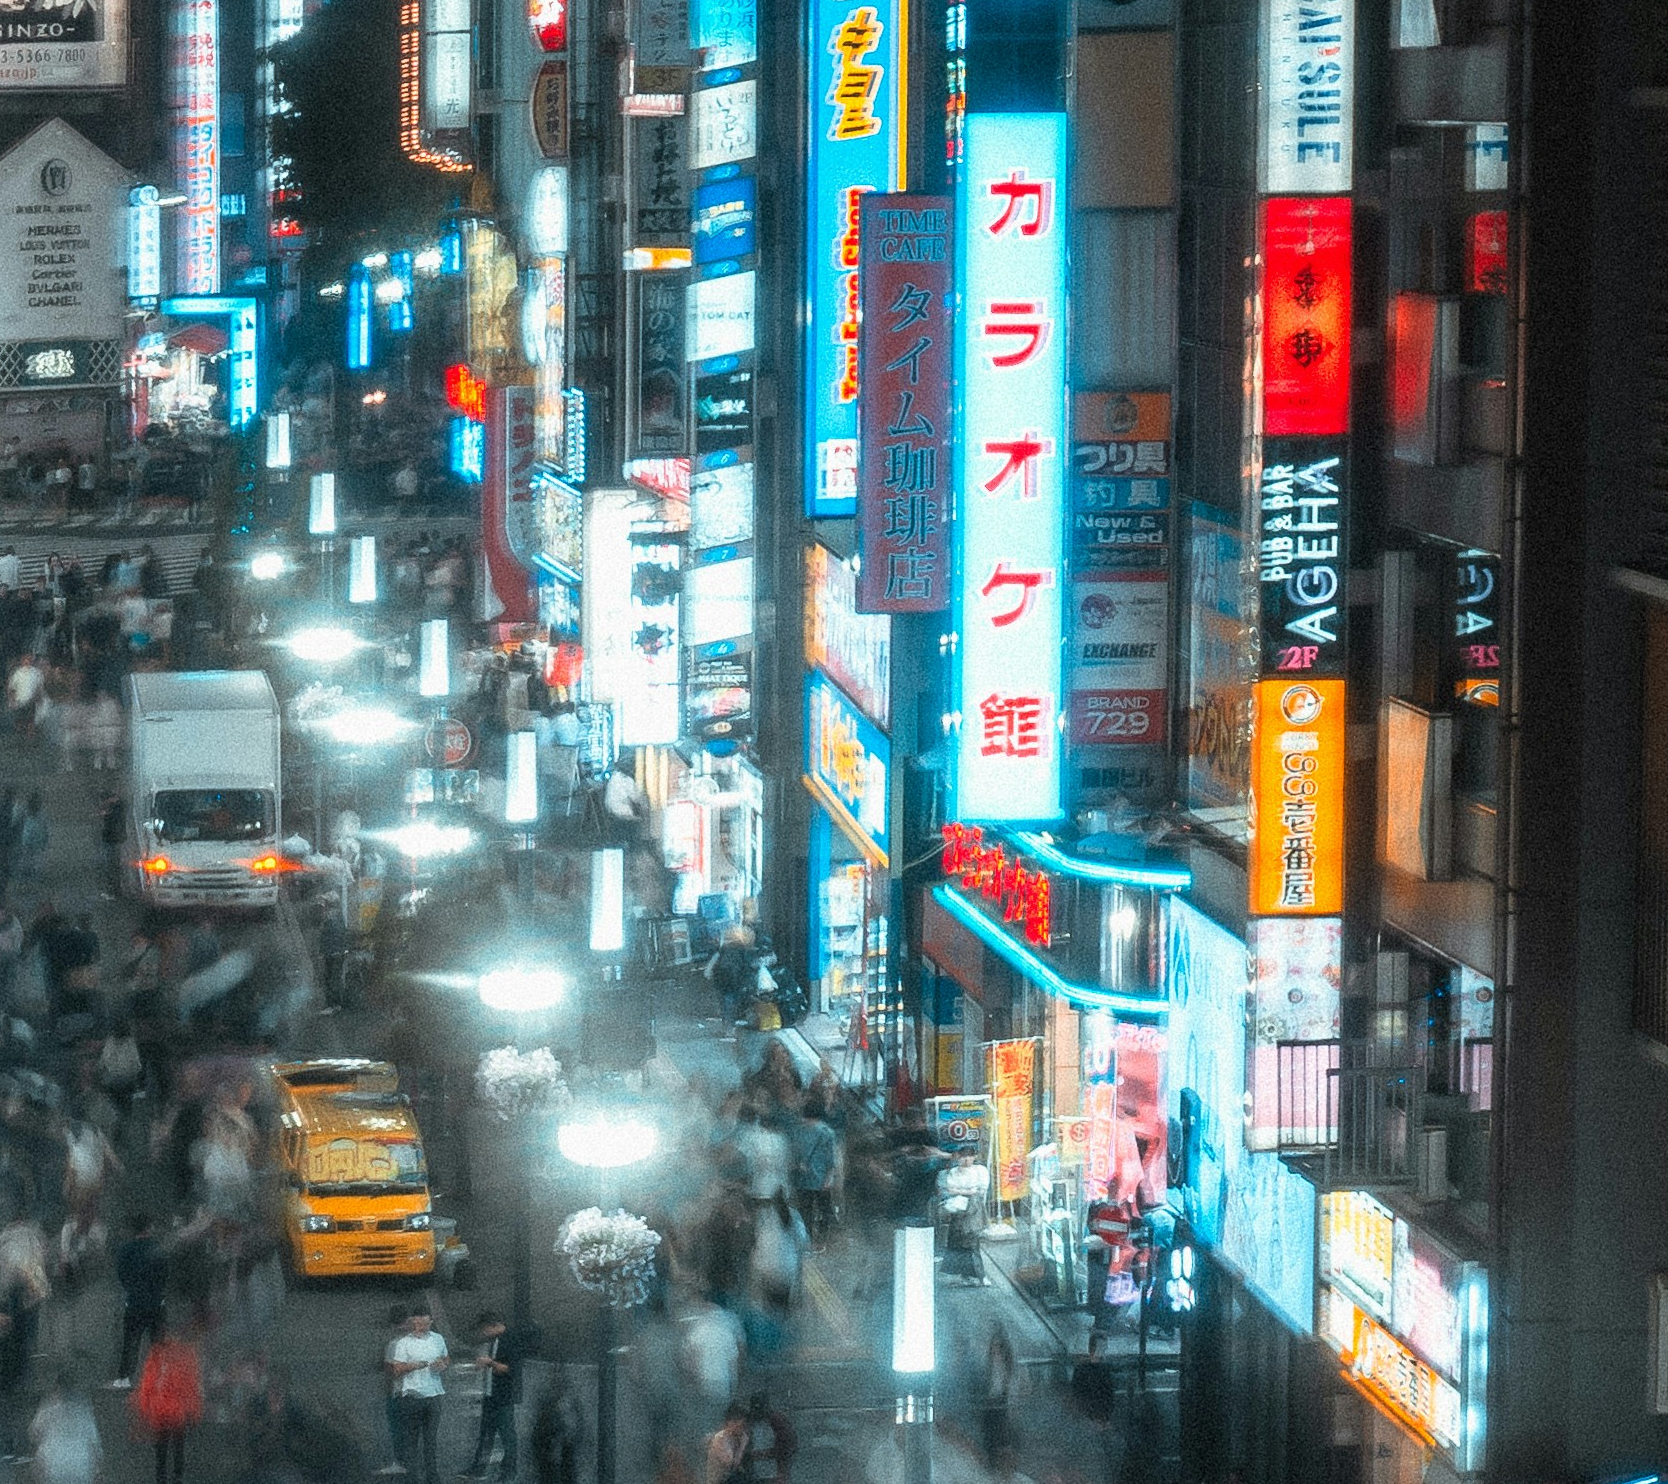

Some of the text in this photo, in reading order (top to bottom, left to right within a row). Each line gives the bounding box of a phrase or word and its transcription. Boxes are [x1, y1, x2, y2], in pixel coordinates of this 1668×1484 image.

[878, 209, 947, 233] TIME
[879, 235, 946, 264] CAFE
[882, 281, 937, 600] タイム珈琲店
[978, 171, 1058, 761] カラオケ館
[1074, 444, 1168, 475] つり具
[1266, 463, 1295, 513] BAR
[1076, 515, 1137, 531] New
[1096, 529, 1163, 546] Used
[1284, 455, 1341, 644] AGEHA
[1265, 529, 1289, 583] PUB
[1082, 641, 1158, 659] EXCHANGE
[1280, 646, 1319, 670] 2F
[1086, 695, 1151, 711] BRAND
[1086, 710, 1150, 736] 729
